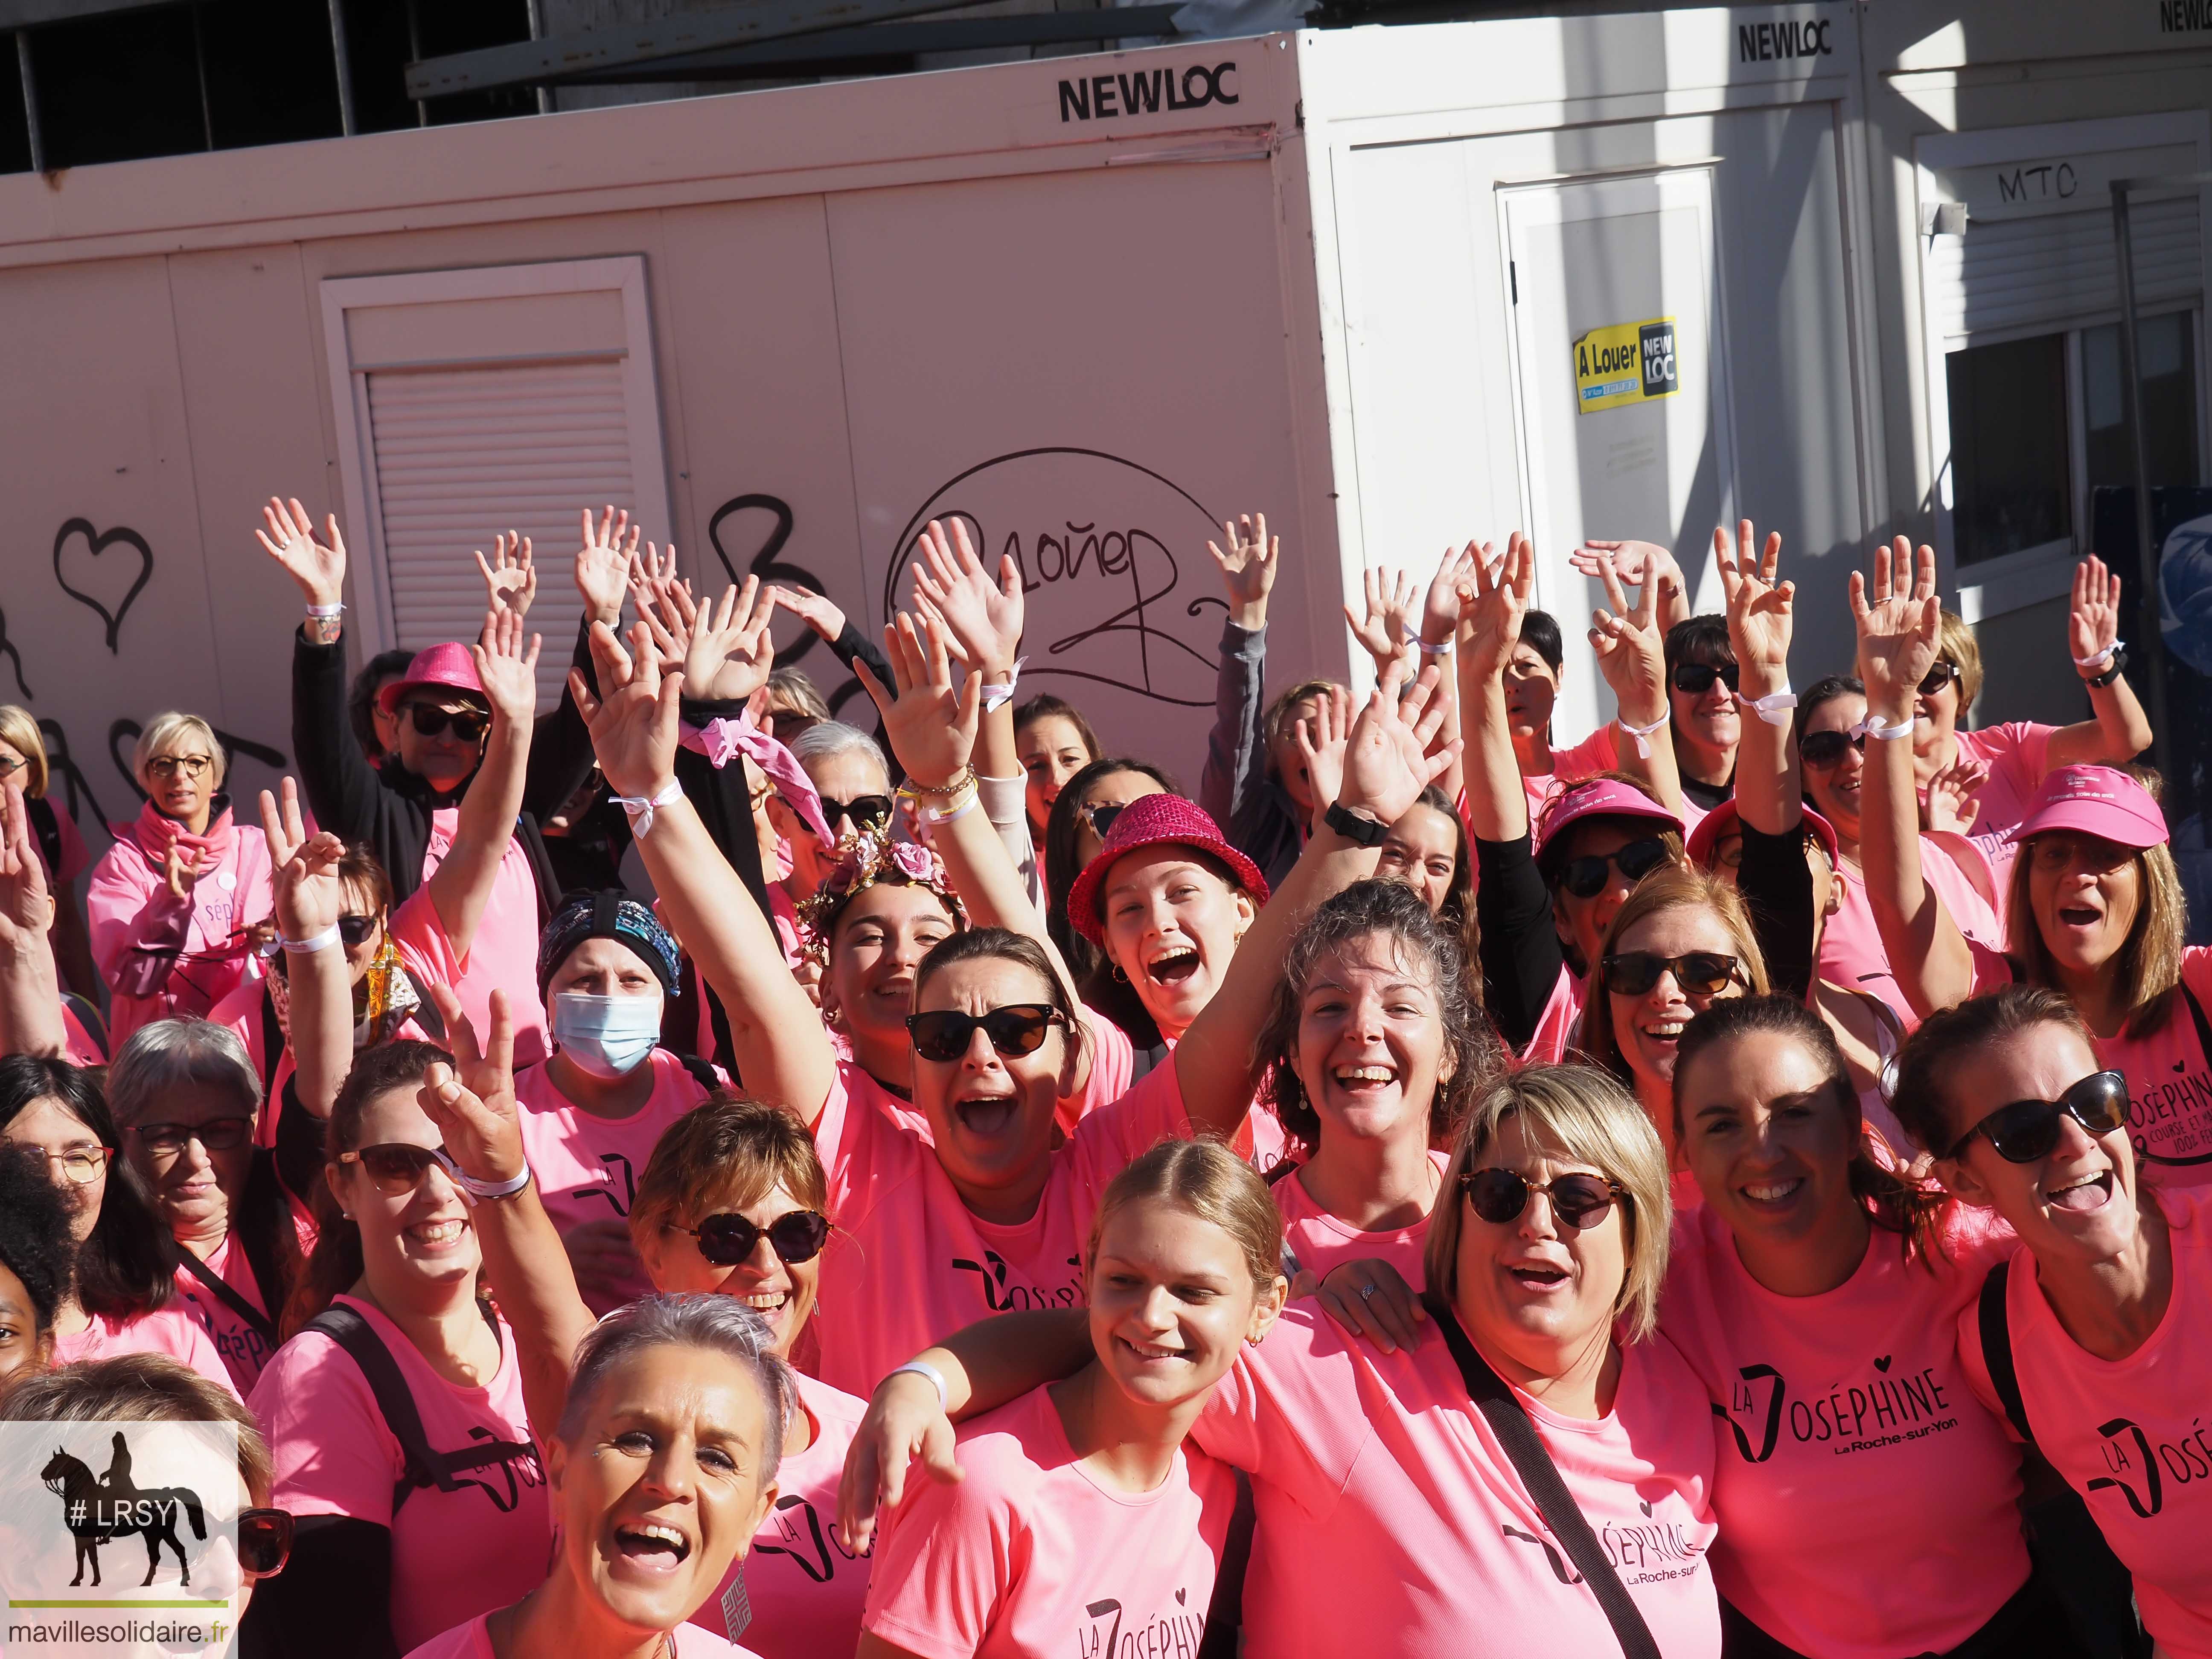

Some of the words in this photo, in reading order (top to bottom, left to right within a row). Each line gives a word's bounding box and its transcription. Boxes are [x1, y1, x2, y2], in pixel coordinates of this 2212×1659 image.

[1739, 19, 1831, 62] NEWLOC
[1058, 62, 1239, 122] NEWLOC
[1579, 346, 1589, 378] A
[1592, 343, 1636, 375] Louer
[1643, 335, 1672, 358] NEW
[1645, 355, 1675, 384] LOC
[2150, 1121, 2187, 1143] COURSE
[2188, 1115, 2201, 1131] ET
[599, 1166, 616, 1186] LA
[1711, 1363, 1949, 1463] JOSÉPHINE
[1733, 1381, 1754, 1415] LA
[1834, 1446, 1850, 1455] La
[1851, 1417, 1958, 1452] Roche-sur-Yon
[2087, 1417, 2212, 1519] JOSÉ
[2101, 1441, 2131, 1473] LA
[773, 1516, 801, 1543] LA
[1627, 1576, 1639, 1585] La
[1639, 1562, 1700, 1583] Roche-sur-
[1079, 1623, 1099, 1659] LA
